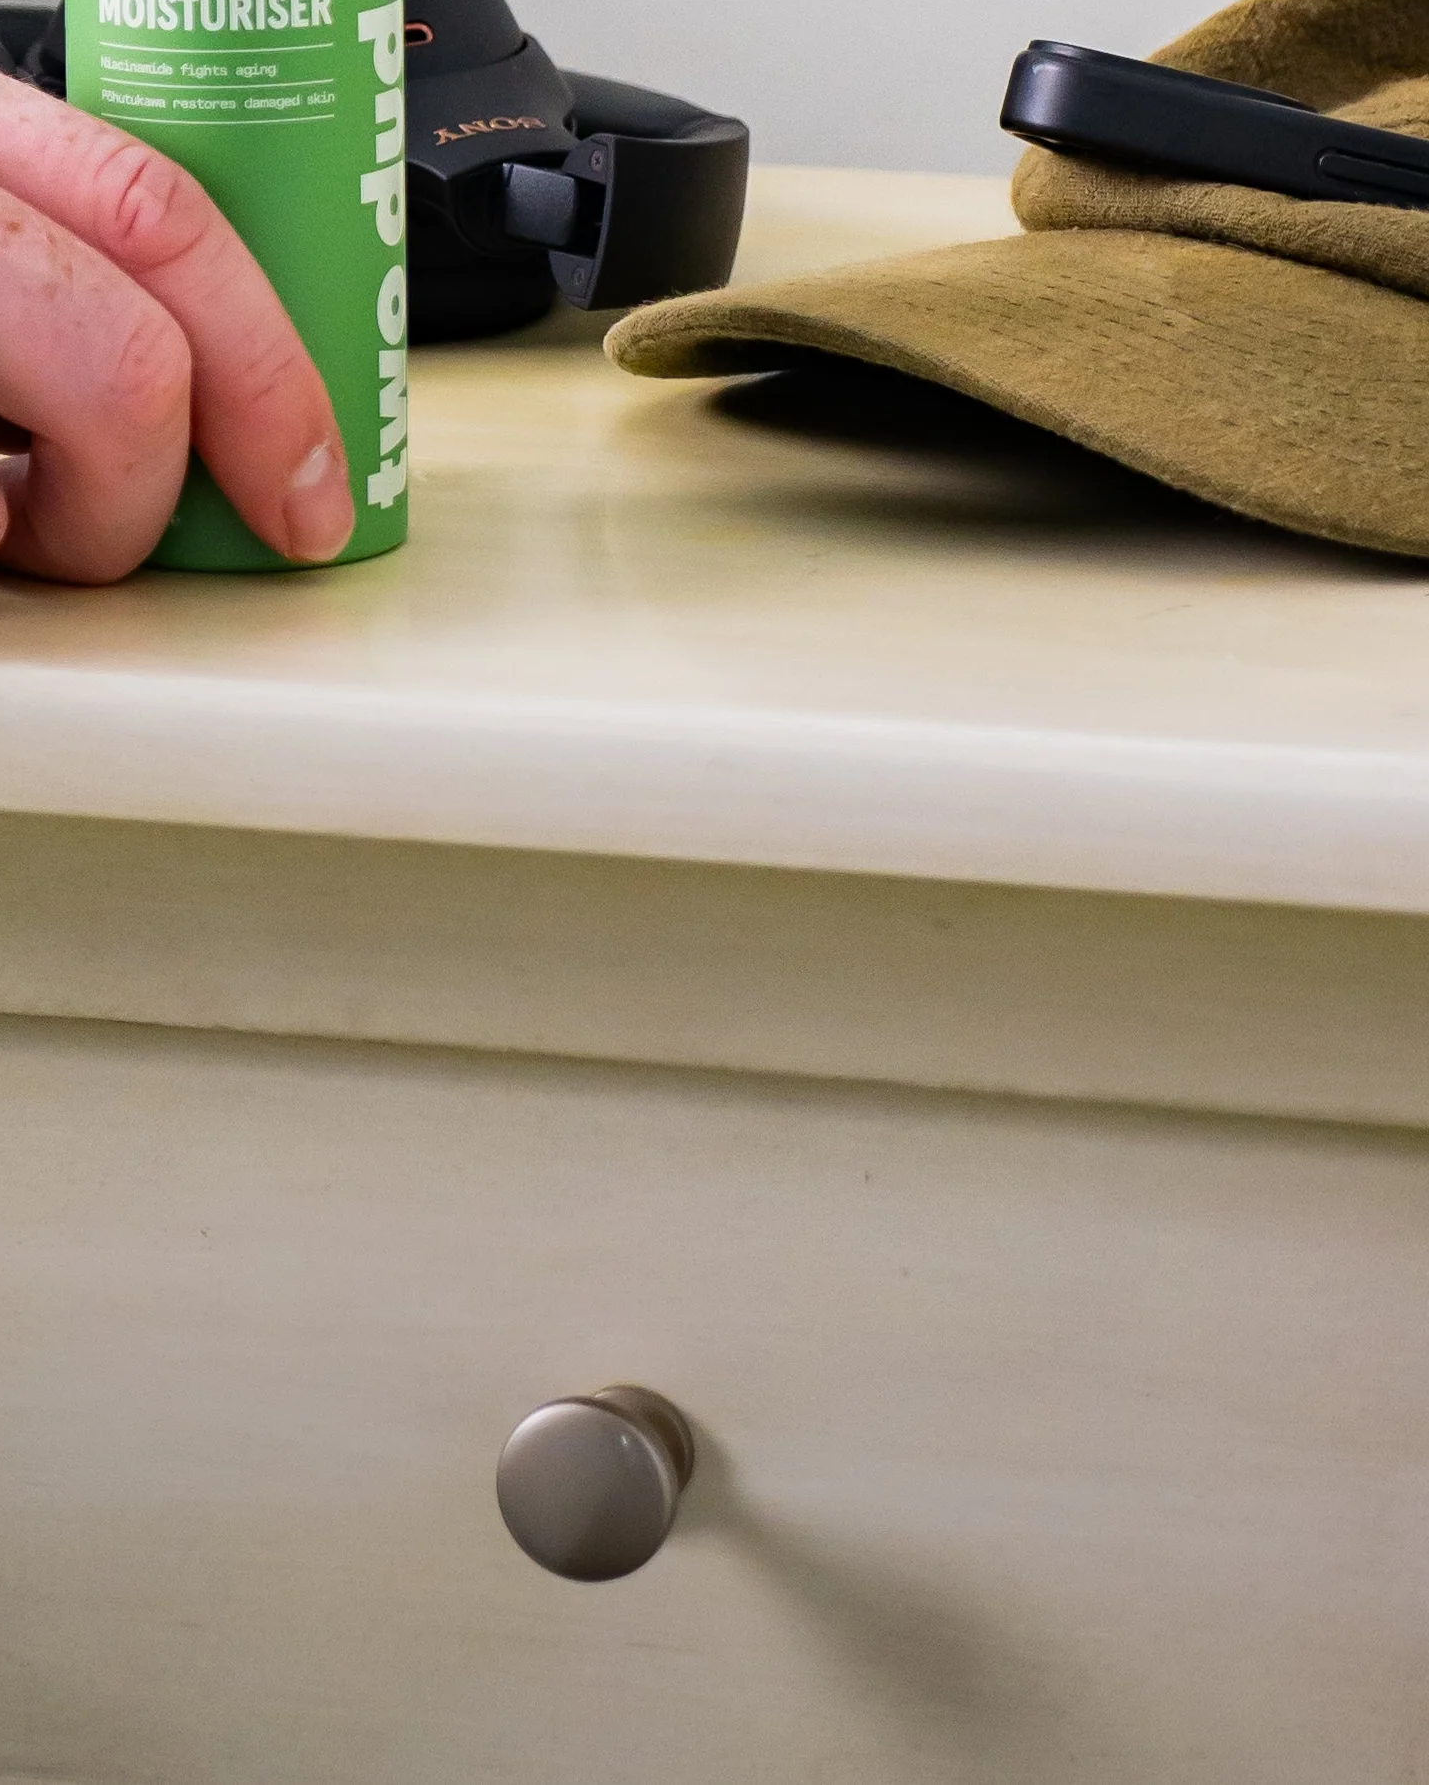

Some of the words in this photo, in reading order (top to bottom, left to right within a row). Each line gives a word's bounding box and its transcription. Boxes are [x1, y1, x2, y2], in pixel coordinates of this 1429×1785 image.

[180, 63, 228, 79] fights
[235, 63, 277, 78] aging
[173, 98, 236, 110] restores
[244, 94, 301, 110] damaged
[307, 91, 335, 106] skin
[367, 263, 407, 510] two
